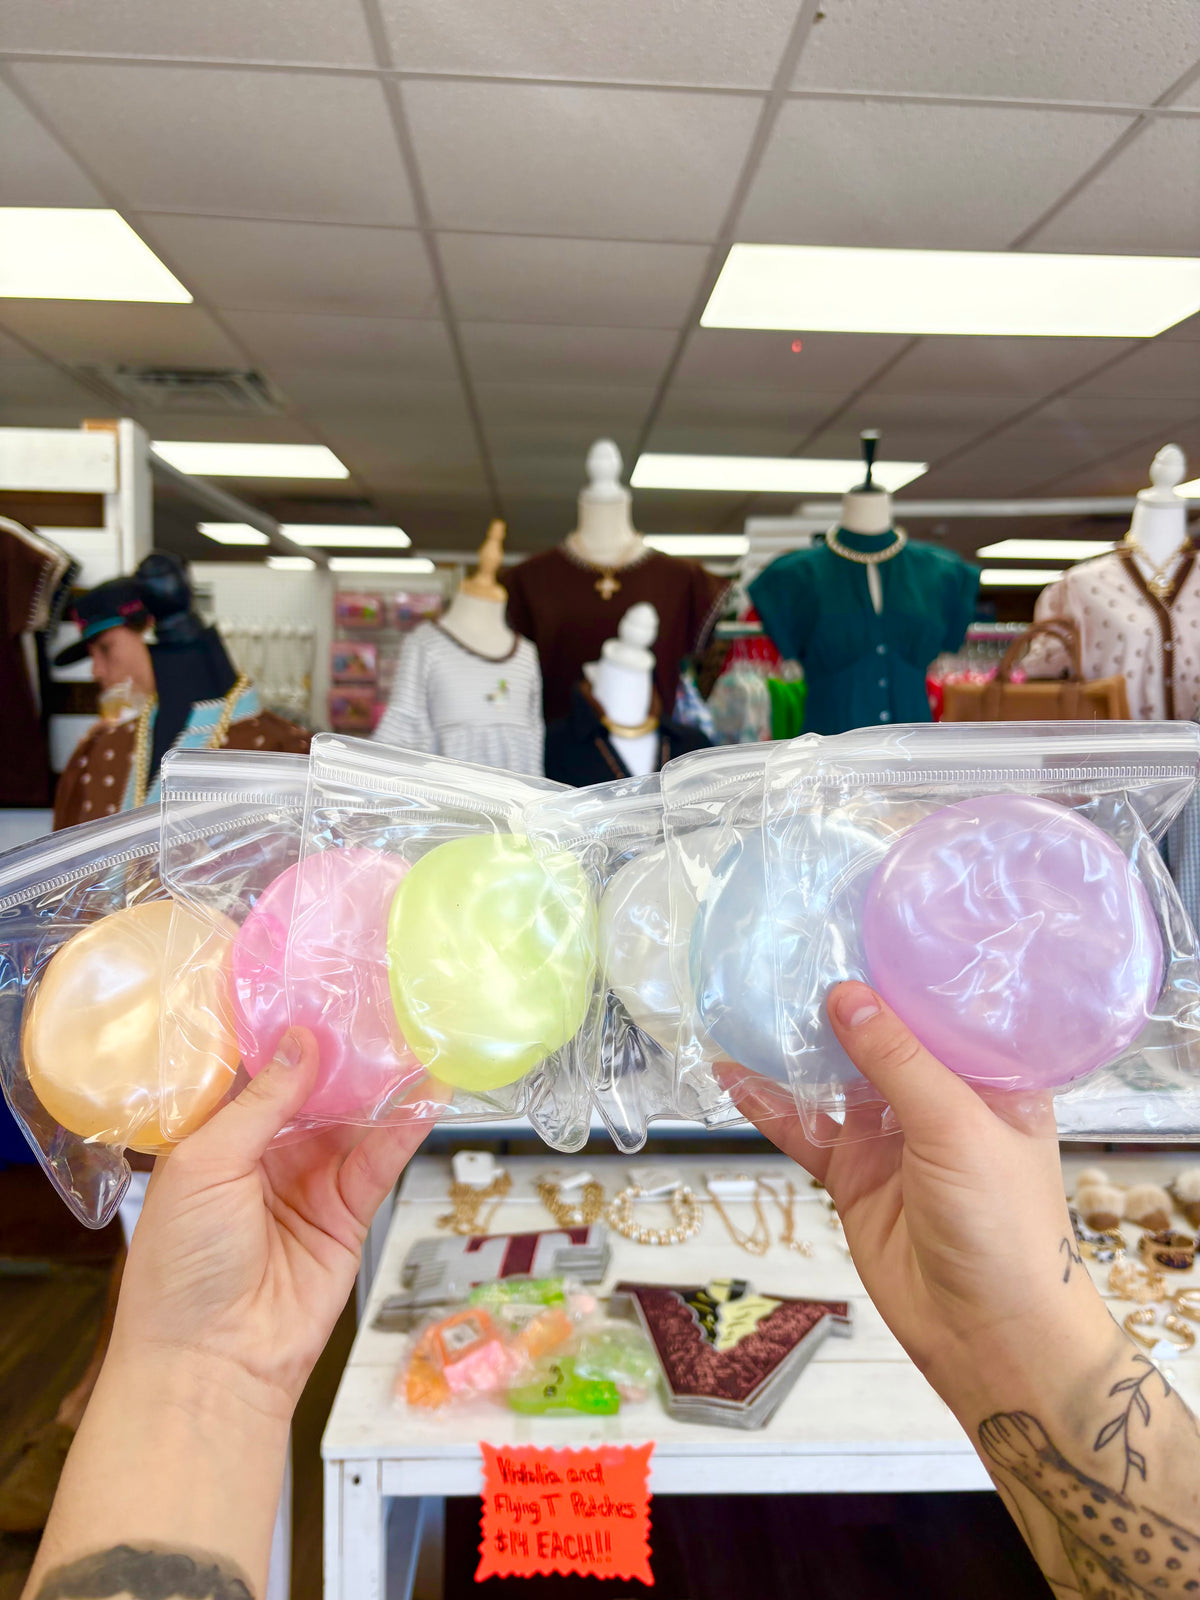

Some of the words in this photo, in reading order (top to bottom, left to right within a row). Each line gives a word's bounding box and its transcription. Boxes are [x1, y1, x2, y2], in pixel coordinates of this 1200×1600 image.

[566, 1463, 606, 1485] and
[494, 1493, 541, 1524] Flying
[541, 1492, 561, 1517] T
[570, 1491, 637, 1519] Patches
[495, 1529, 529, 1557] $14
[536, 1530, 612, 1564] EACH!!
